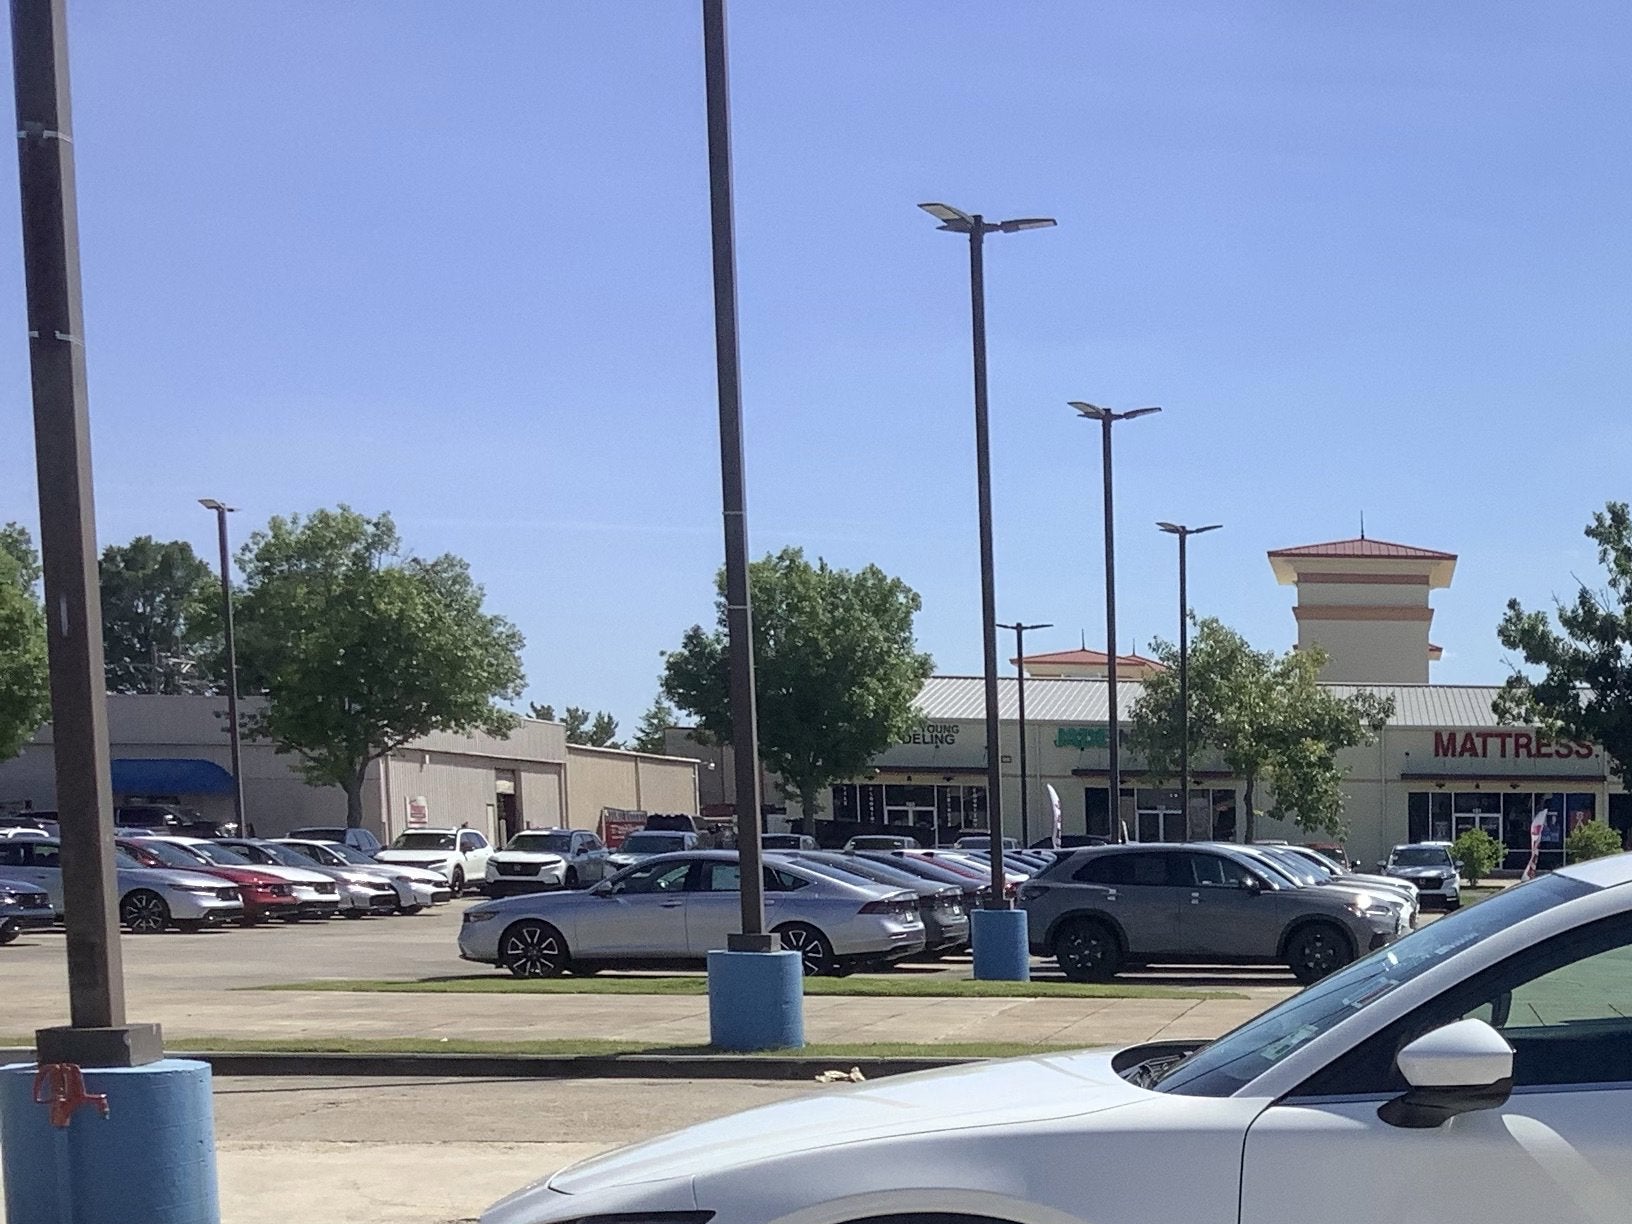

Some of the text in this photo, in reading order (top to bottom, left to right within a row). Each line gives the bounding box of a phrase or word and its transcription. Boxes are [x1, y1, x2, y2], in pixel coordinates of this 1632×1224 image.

[920, 724, 960, 734] YOUNG
[902, 734, 956, 745] DELING
[1433, 730, 1594, 759] MATTRESS
